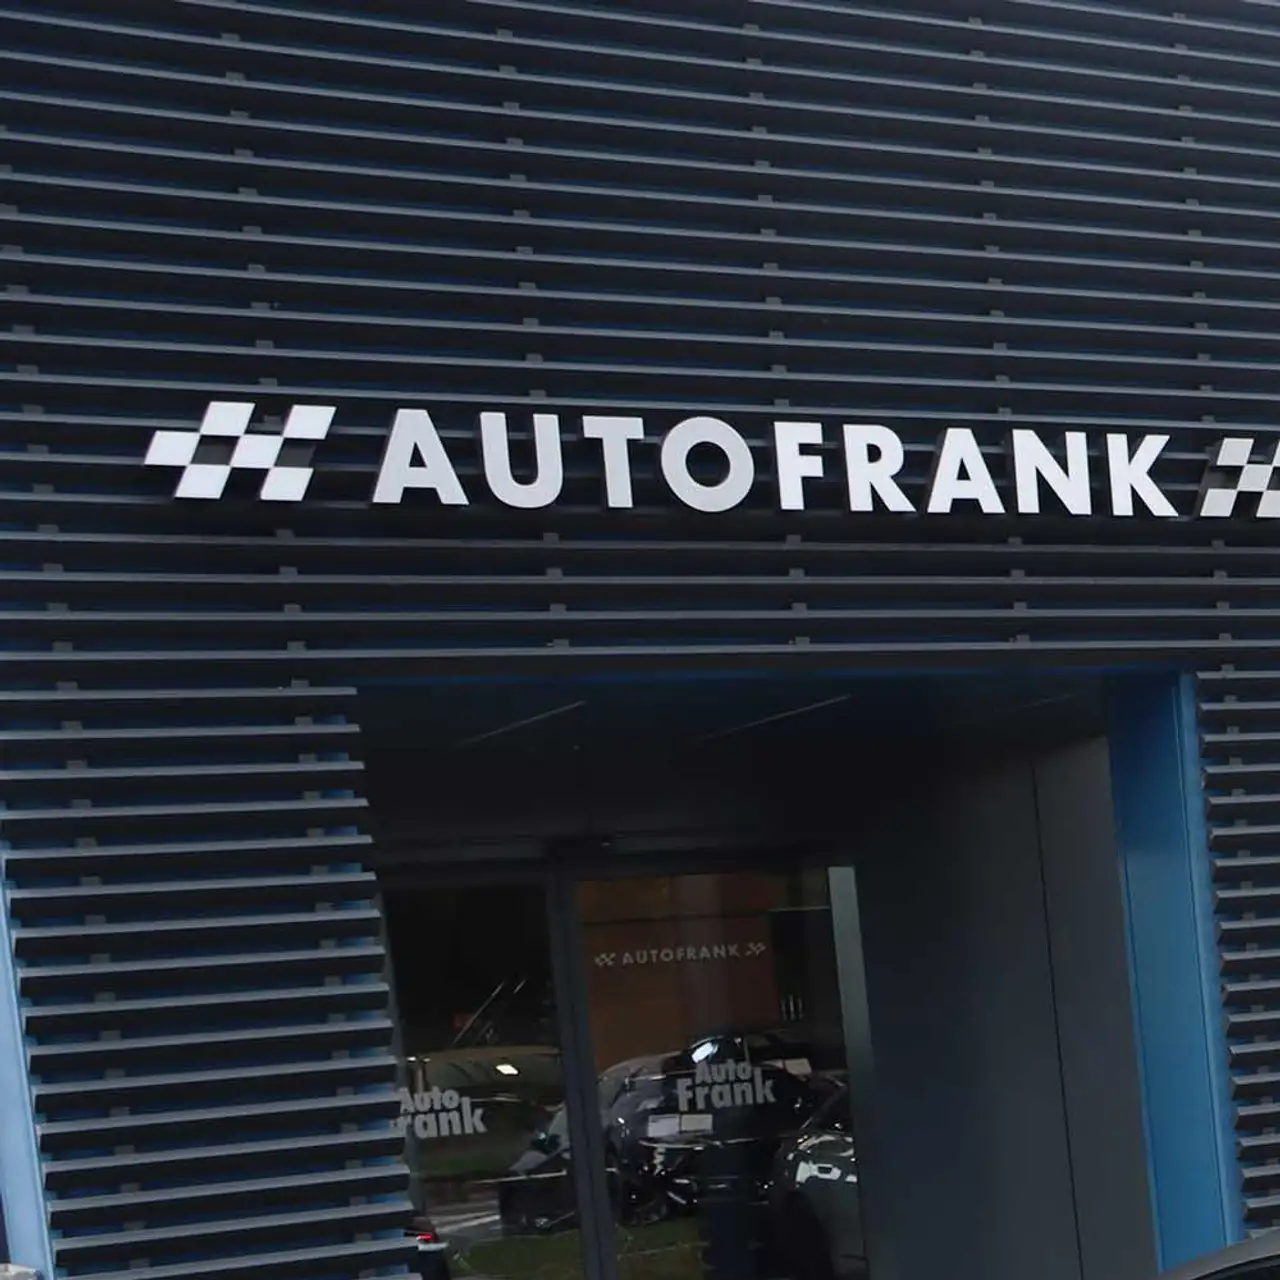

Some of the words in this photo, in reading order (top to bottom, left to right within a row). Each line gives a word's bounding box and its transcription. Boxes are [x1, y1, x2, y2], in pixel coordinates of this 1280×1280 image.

[372, 408, 1179, 517] AUTOFRANK
[622, 944, 740, 966] AUTOFRANK
[676, 1067, 776, 1111] Frank
[695, 1059, 751, 1083] Auto
[390, 1096, 487, 1138] rank
